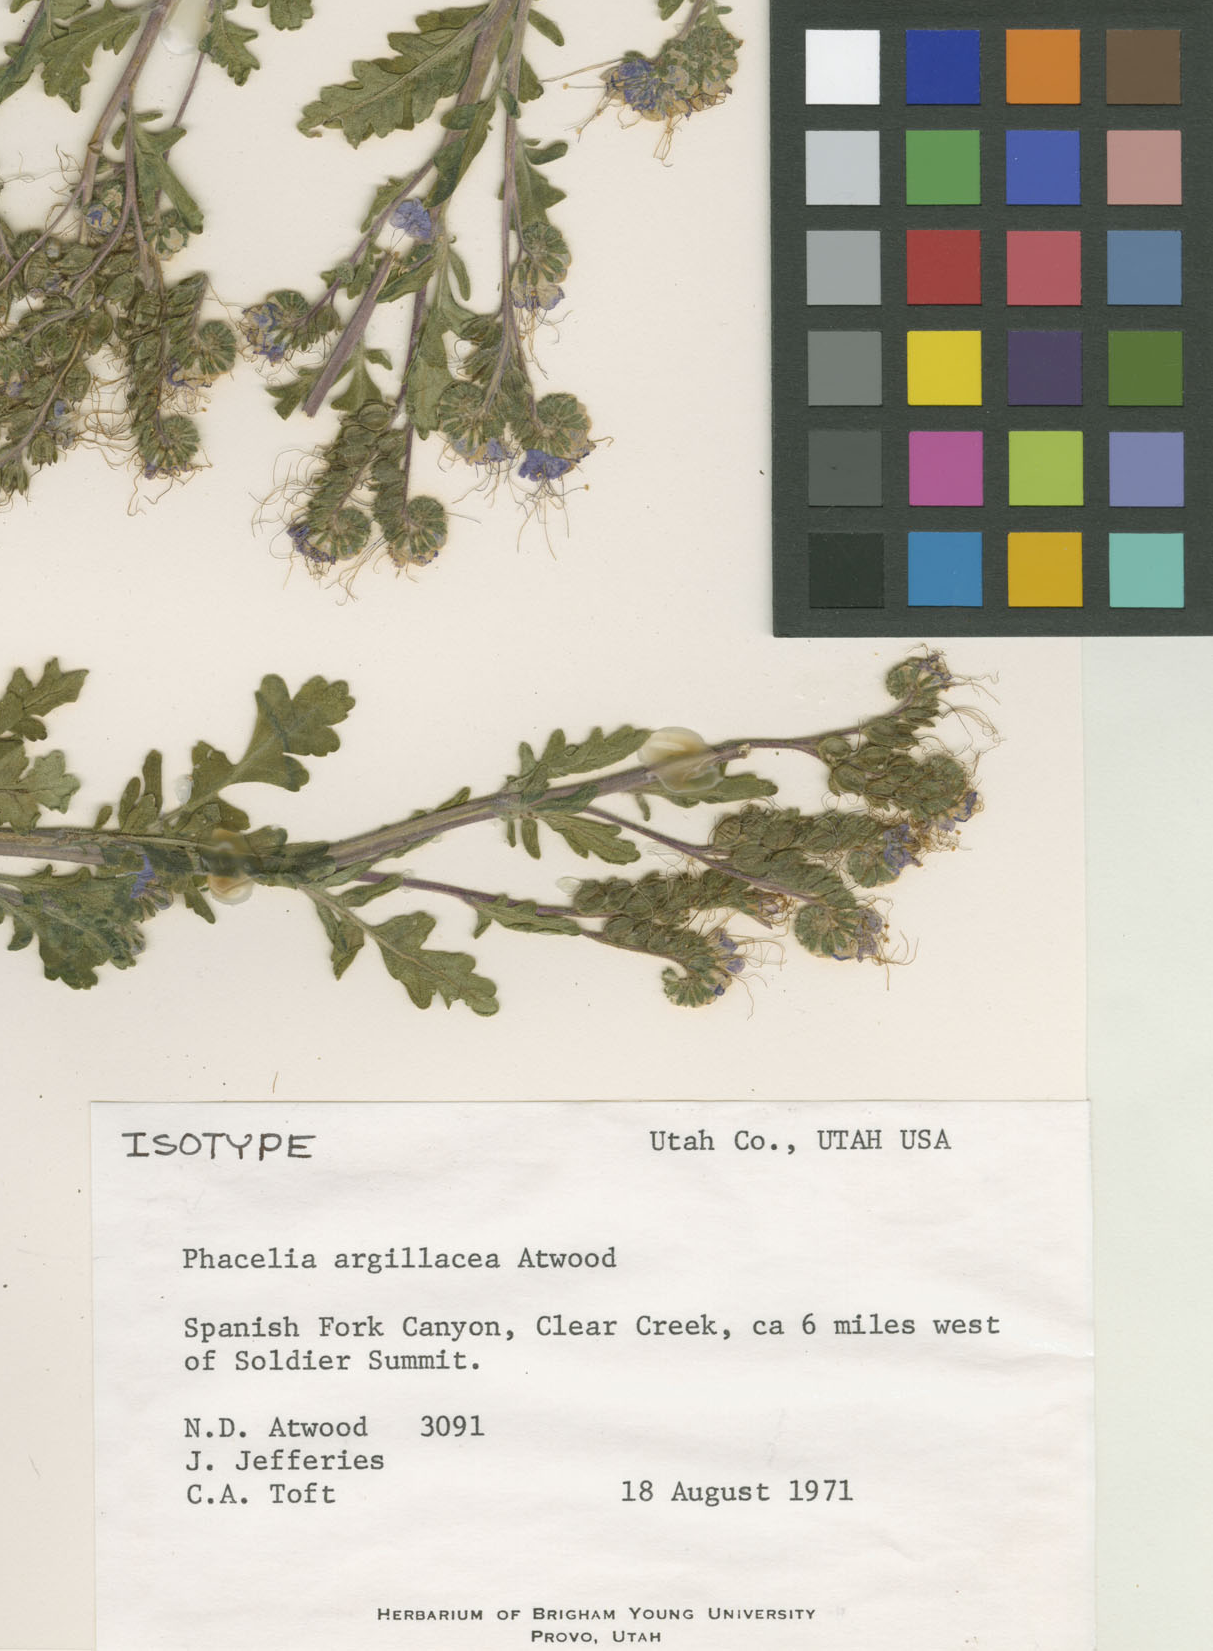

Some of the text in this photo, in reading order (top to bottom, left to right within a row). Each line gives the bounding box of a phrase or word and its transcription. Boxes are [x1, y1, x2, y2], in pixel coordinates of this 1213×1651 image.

[121, 1131, 316, 1162] ISOTYPE
[649, 1128, 952, 1155] Utah Co., UTAH USA
[182, 1246, 617, 1274] Phacelia argillacea Atwood
[184, 1312, 1000, 1343] Spanish Fork Canyon, Clear Creek, ca 6 miles west
[184, 1349, 480, 1371] of Soldier Summit.
[184, 1415, 485, 1438] N.D. Atwood 3091
[185, 1448, 384, 1471] J. Jefferies
[187, 1482, 336, 1505] C.A. Toft
[622, 1479, 854, 1507] 18 August 1971
